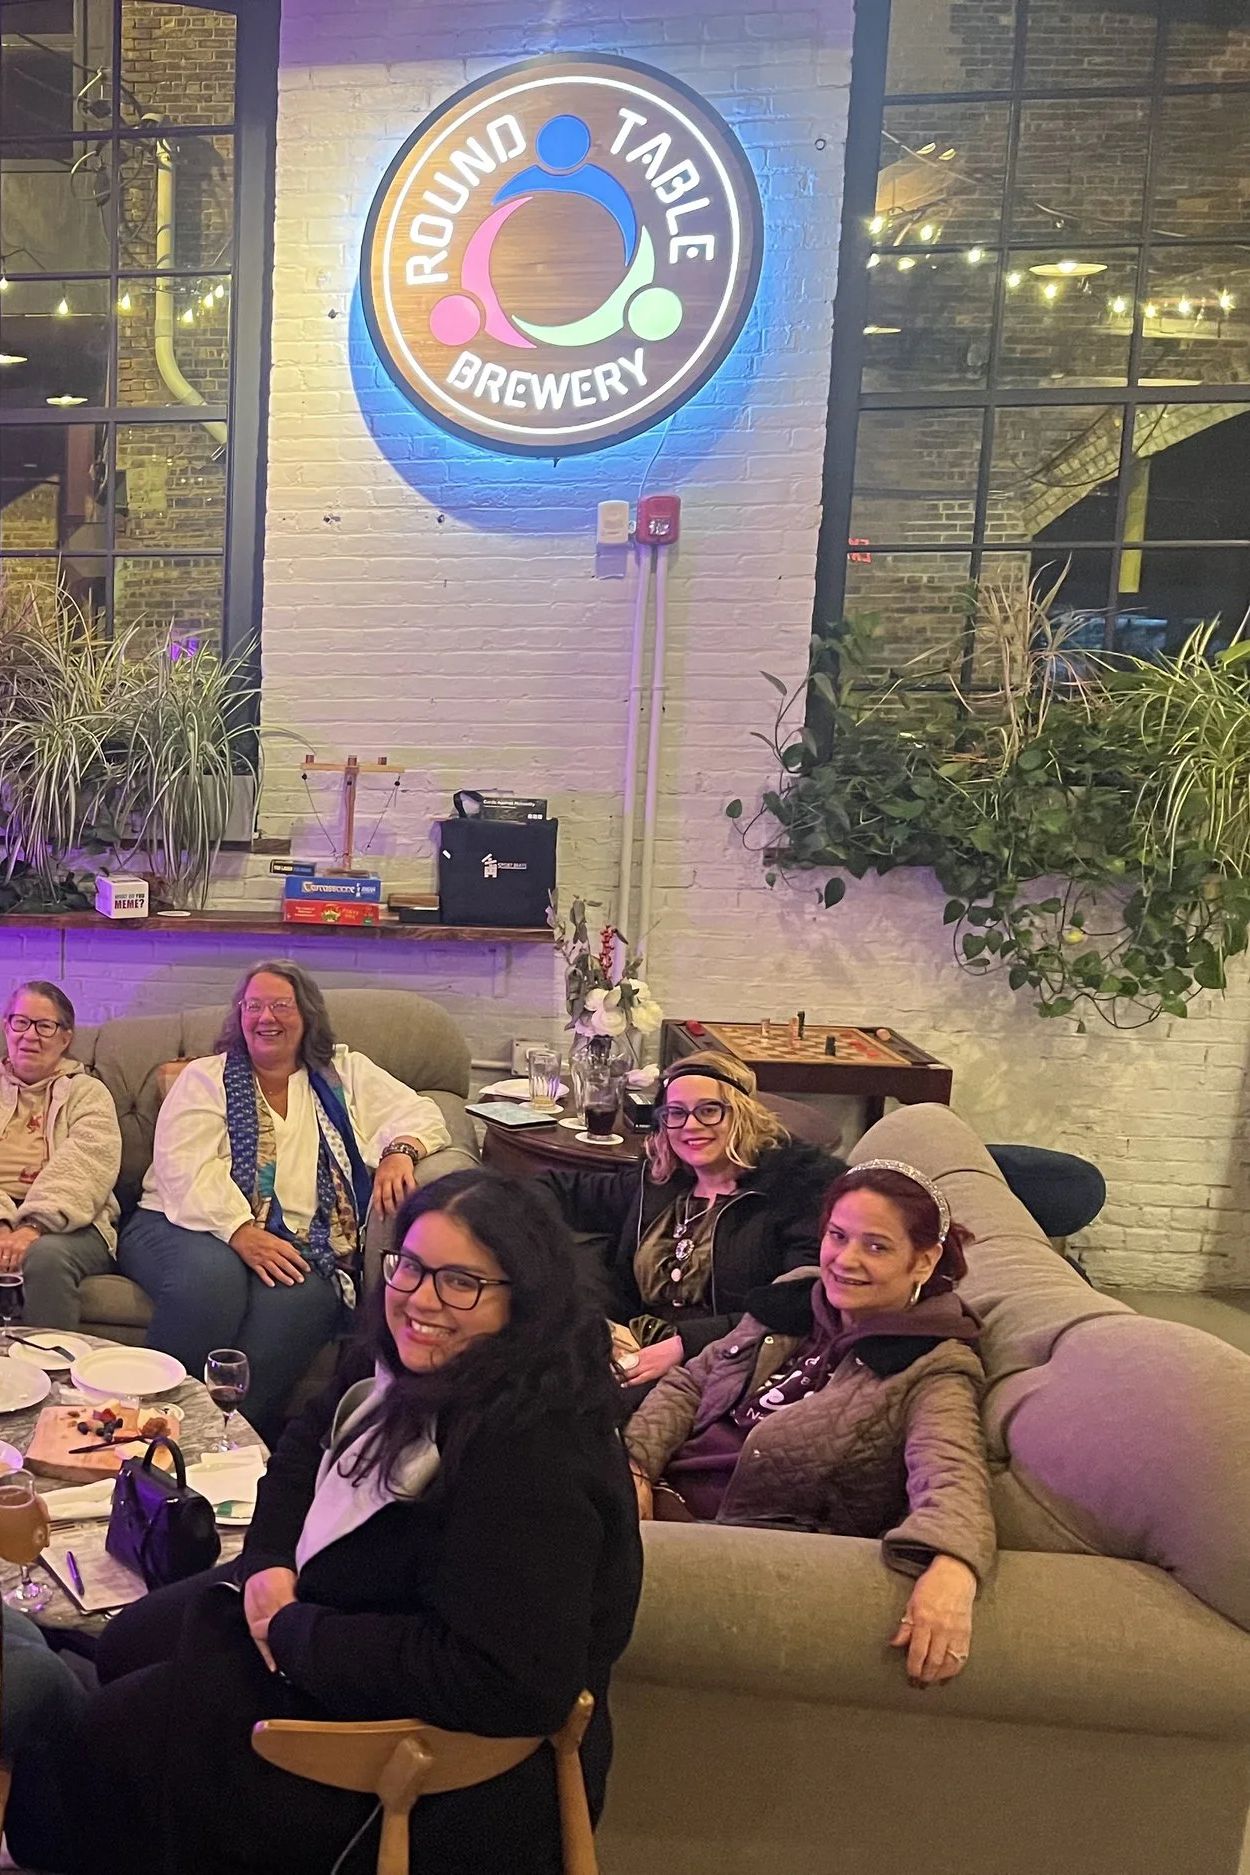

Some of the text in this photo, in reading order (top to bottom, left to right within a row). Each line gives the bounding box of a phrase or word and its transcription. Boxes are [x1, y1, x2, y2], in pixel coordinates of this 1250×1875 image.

[406, 107, 715, 285] ROUND TABLE
[446, 347, 649, 410] BREWERY
[114, 899, 145, 909] MEME?
